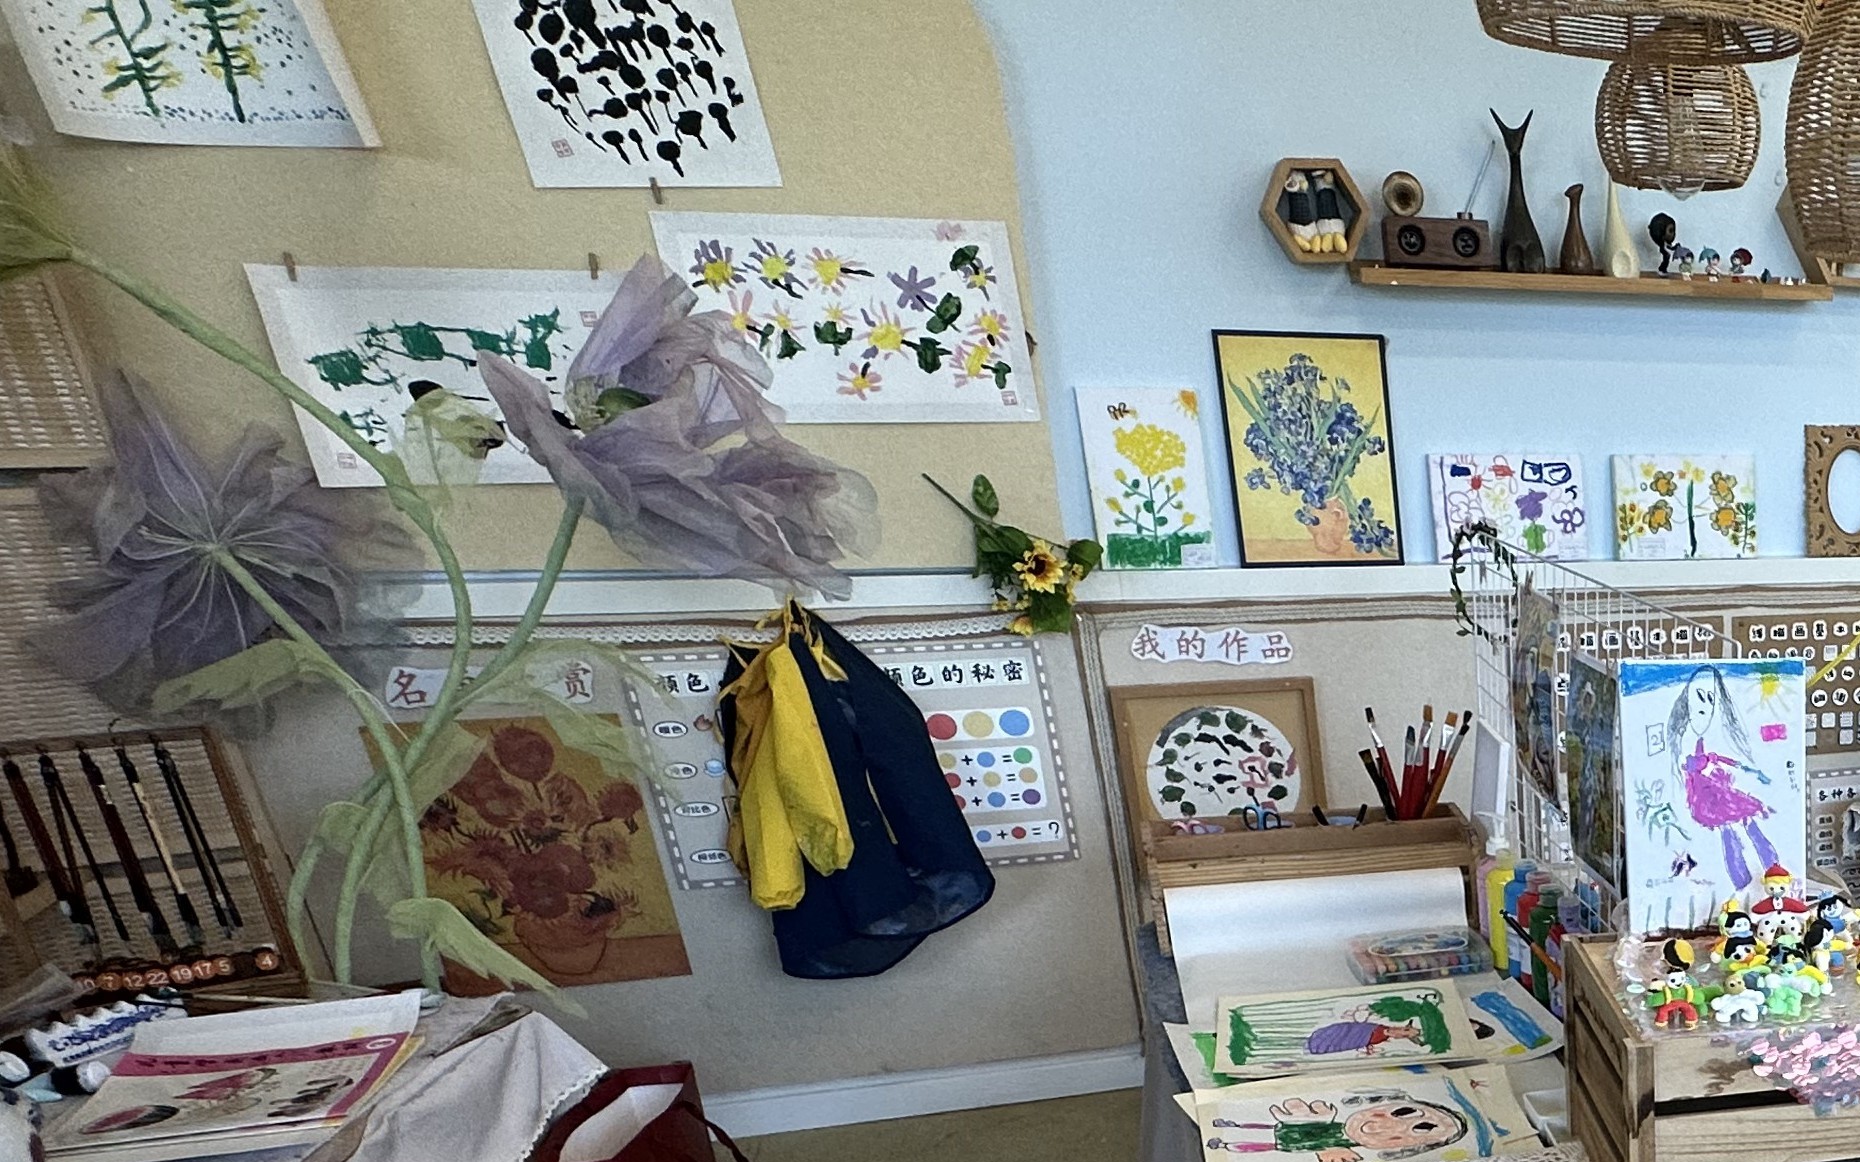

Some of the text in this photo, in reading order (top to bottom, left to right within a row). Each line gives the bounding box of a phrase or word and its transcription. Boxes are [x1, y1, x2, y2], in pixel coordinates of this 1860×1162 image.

[1133, 626, 1291, 662] 我的作品
[884, 660, 1024, 688] 颜色的秘密
[105, 976, 115, 987] 7
[124, 975, 146, 988] 12
[149, 971, 170, 984] 22
[174, 967, 193, 980] 19
[194, 961, 213, 976] 17
[218, 960, 231, 973] 5
[262, 955, 274, 968] 4
